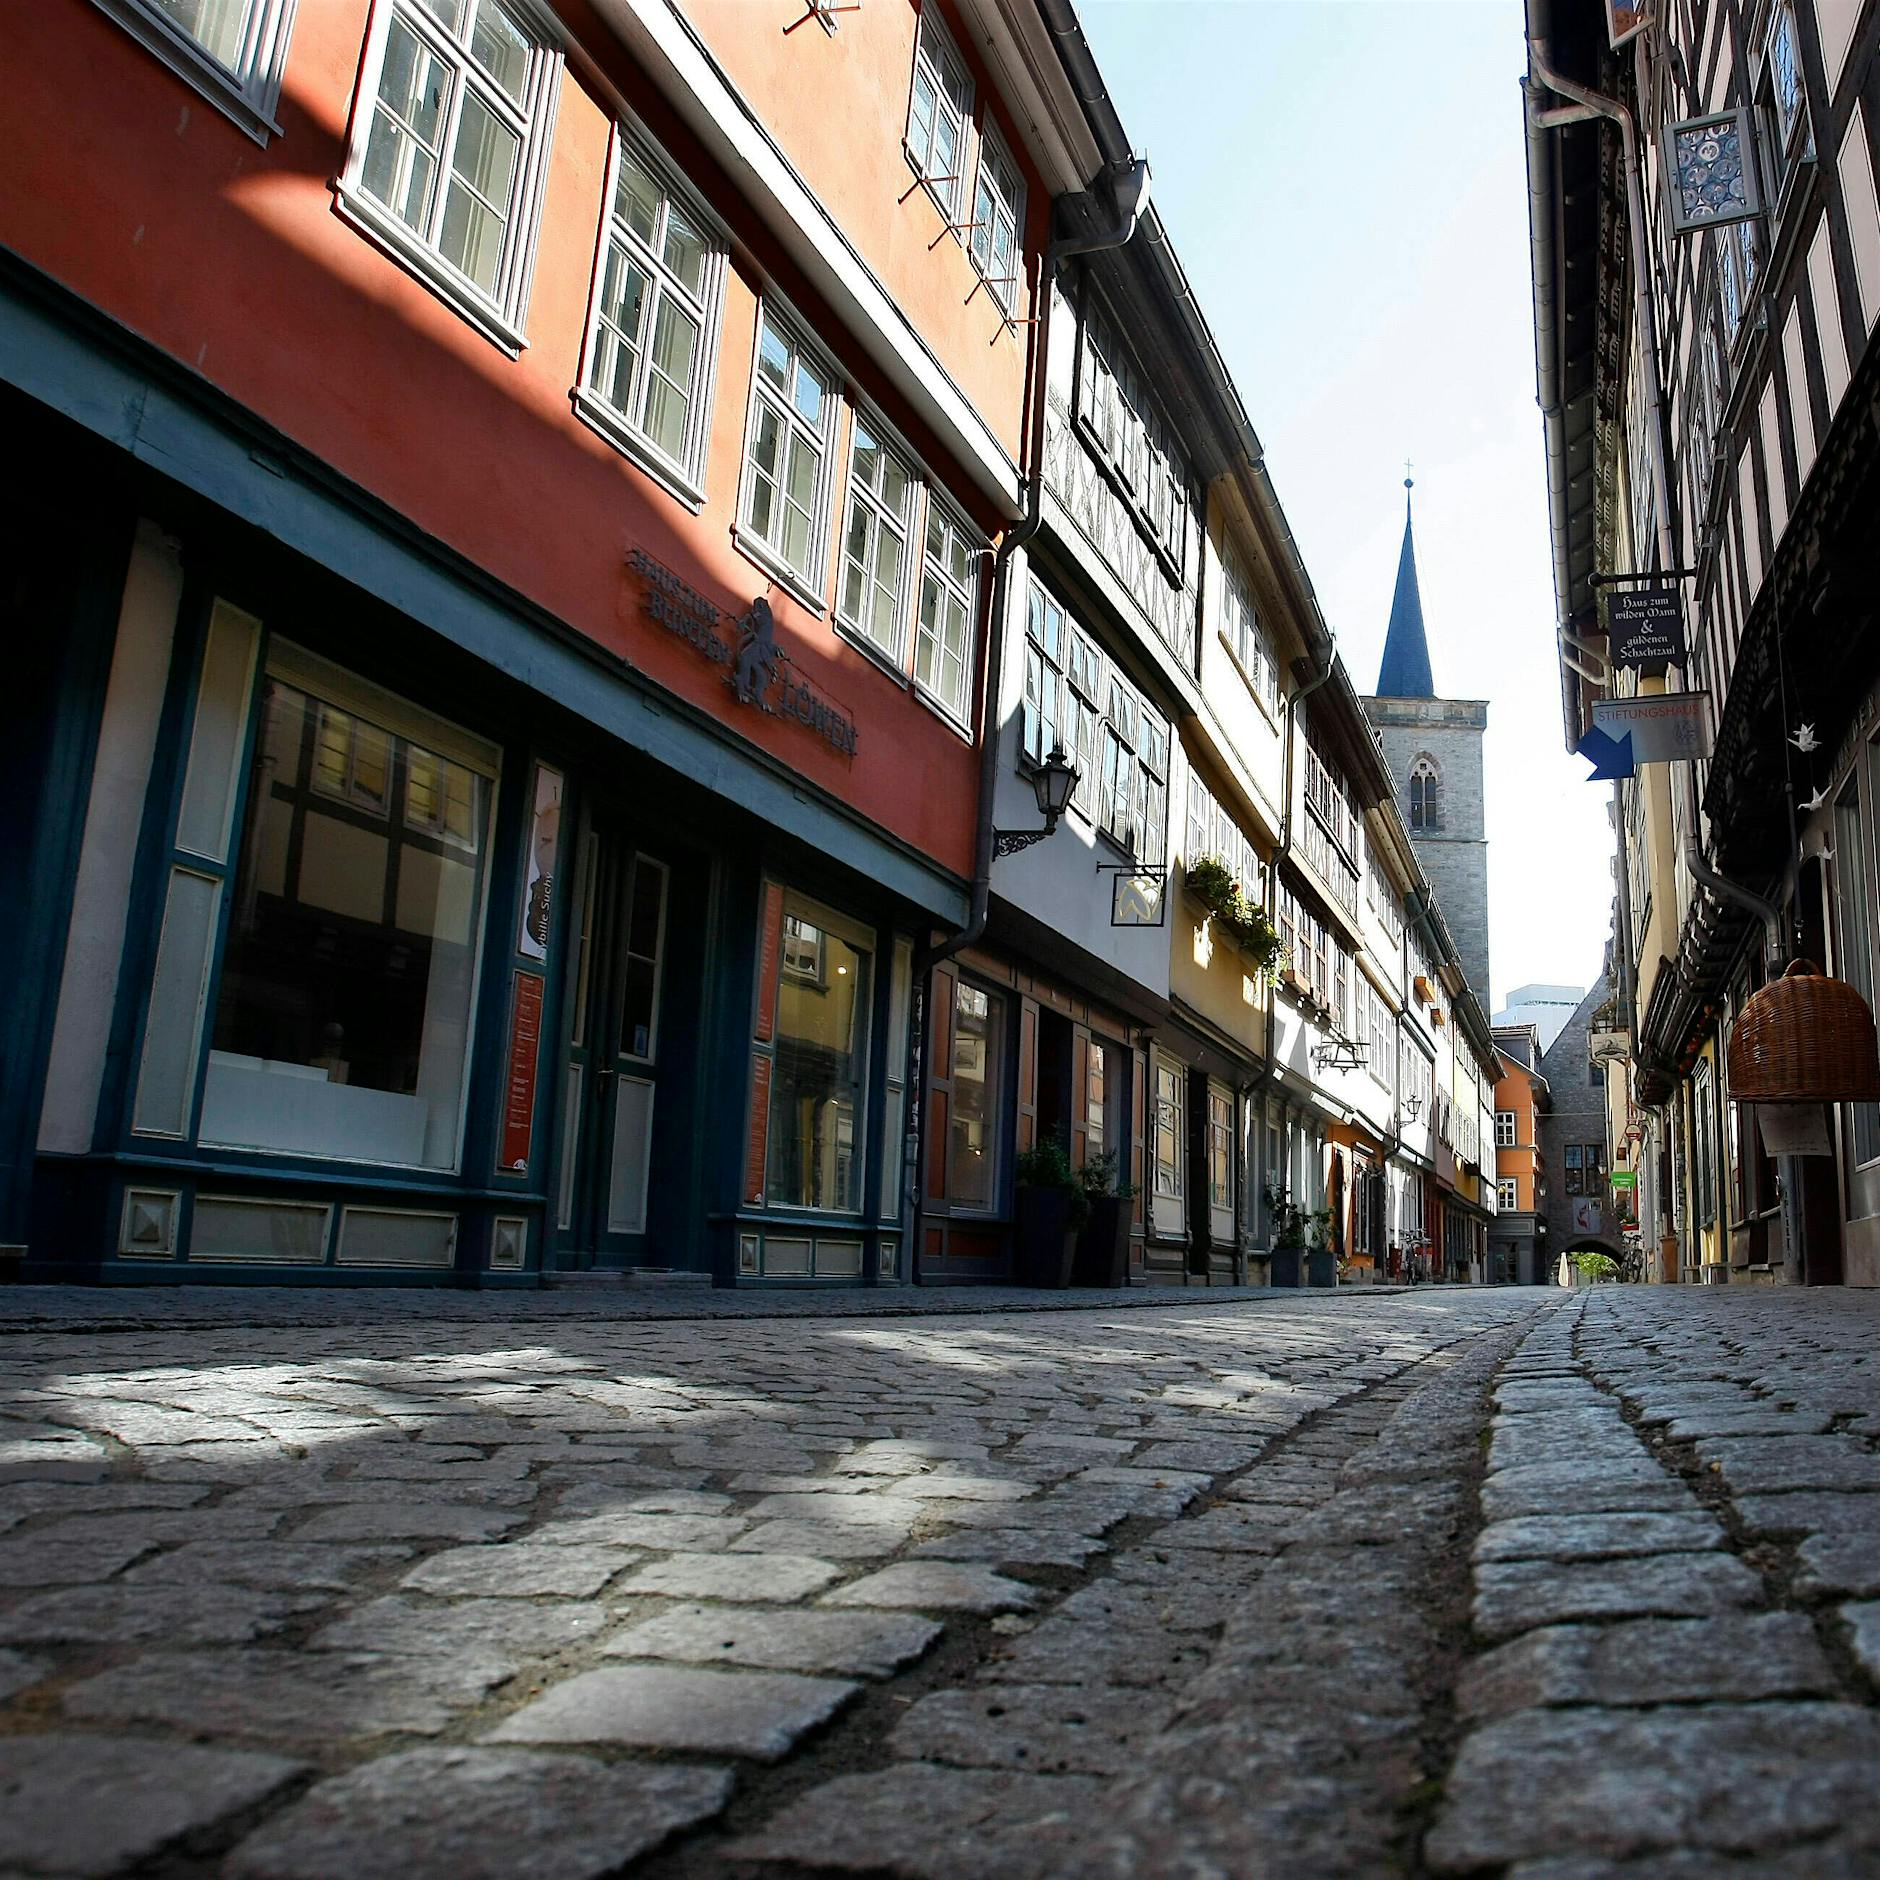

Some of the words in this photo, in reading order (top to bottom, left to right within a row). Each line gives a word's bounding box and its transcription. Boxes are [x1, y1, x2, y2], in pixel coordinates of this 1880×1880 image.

[1622, 596, 1648, 610] Haus
[1649, 597, 1669, 606] zum
[1615, 609, 1645, 620] wilden
[1646, 607, 1676, 617] Mann
[1640, 619, 1654, 634] &
[1626, 635, 1668, 648] güldenen
[782, 668, 858, 756] LÖWEN
[1598, 703, 1700, 722] STIFTUNGSHAUS
[541, 871, 554, 910] Suchy
[536, 914, 549, 953] ybille
